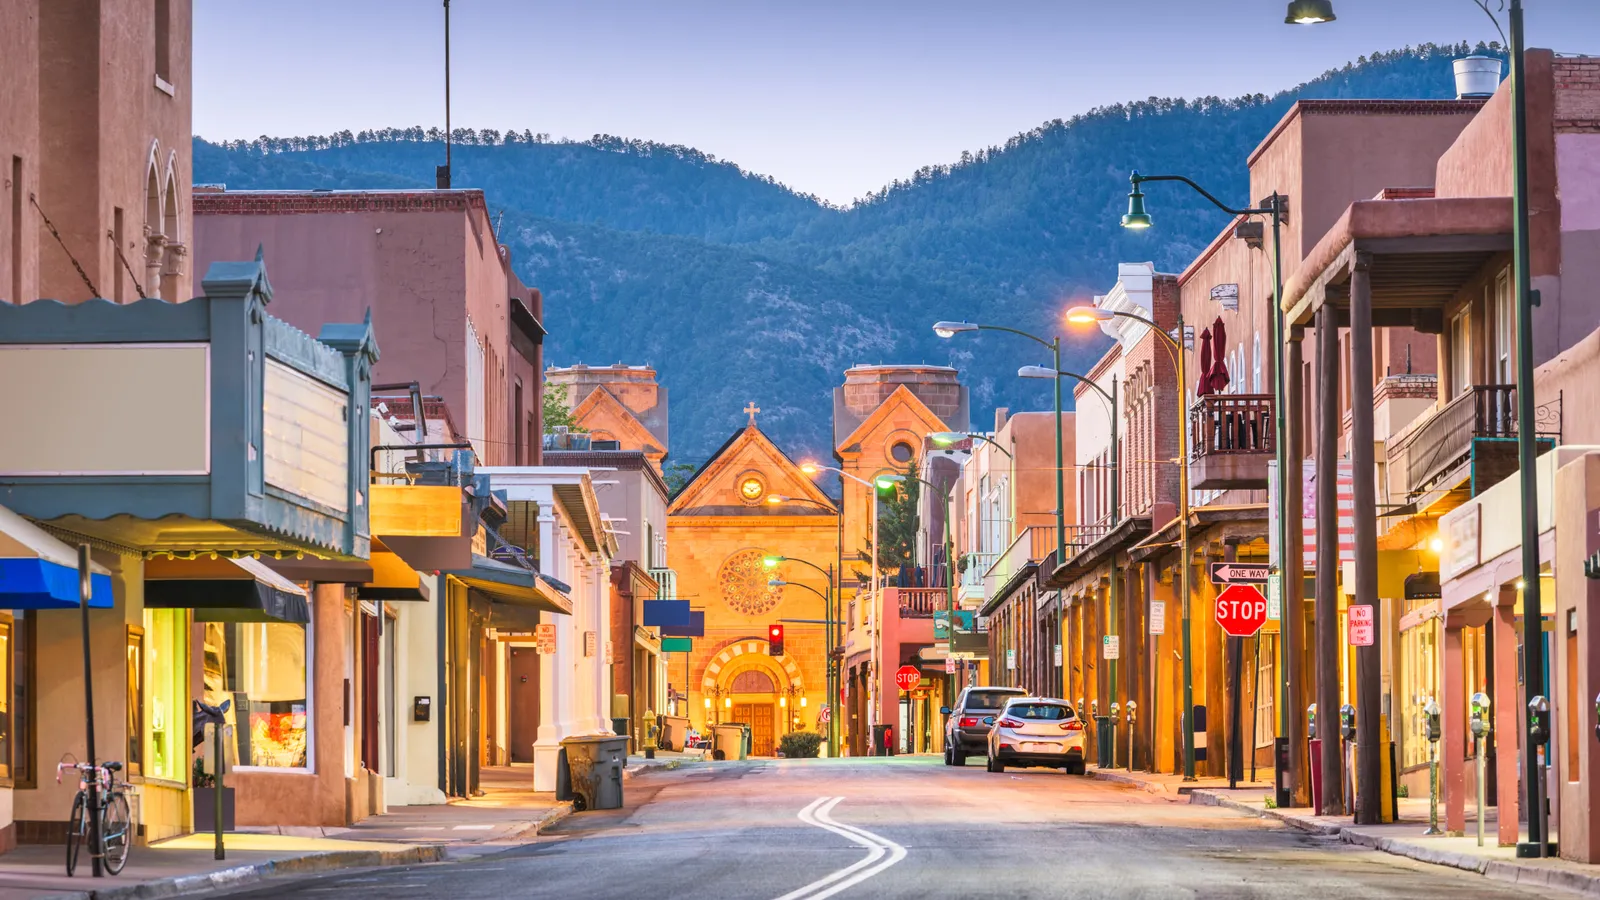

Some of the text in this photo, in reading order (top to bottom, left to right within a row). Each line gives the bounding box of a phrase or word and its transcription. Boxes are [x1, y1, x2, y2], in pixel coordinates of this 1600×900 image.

[1230, 569, 1266, 578] ONE WAY
[1217, 601, 1265, 620] STOP
[1356, 609, 1366, 617] NO
[1350, 620, 1372, 628] PARKING
[897, 673, 919, 683] STOP
